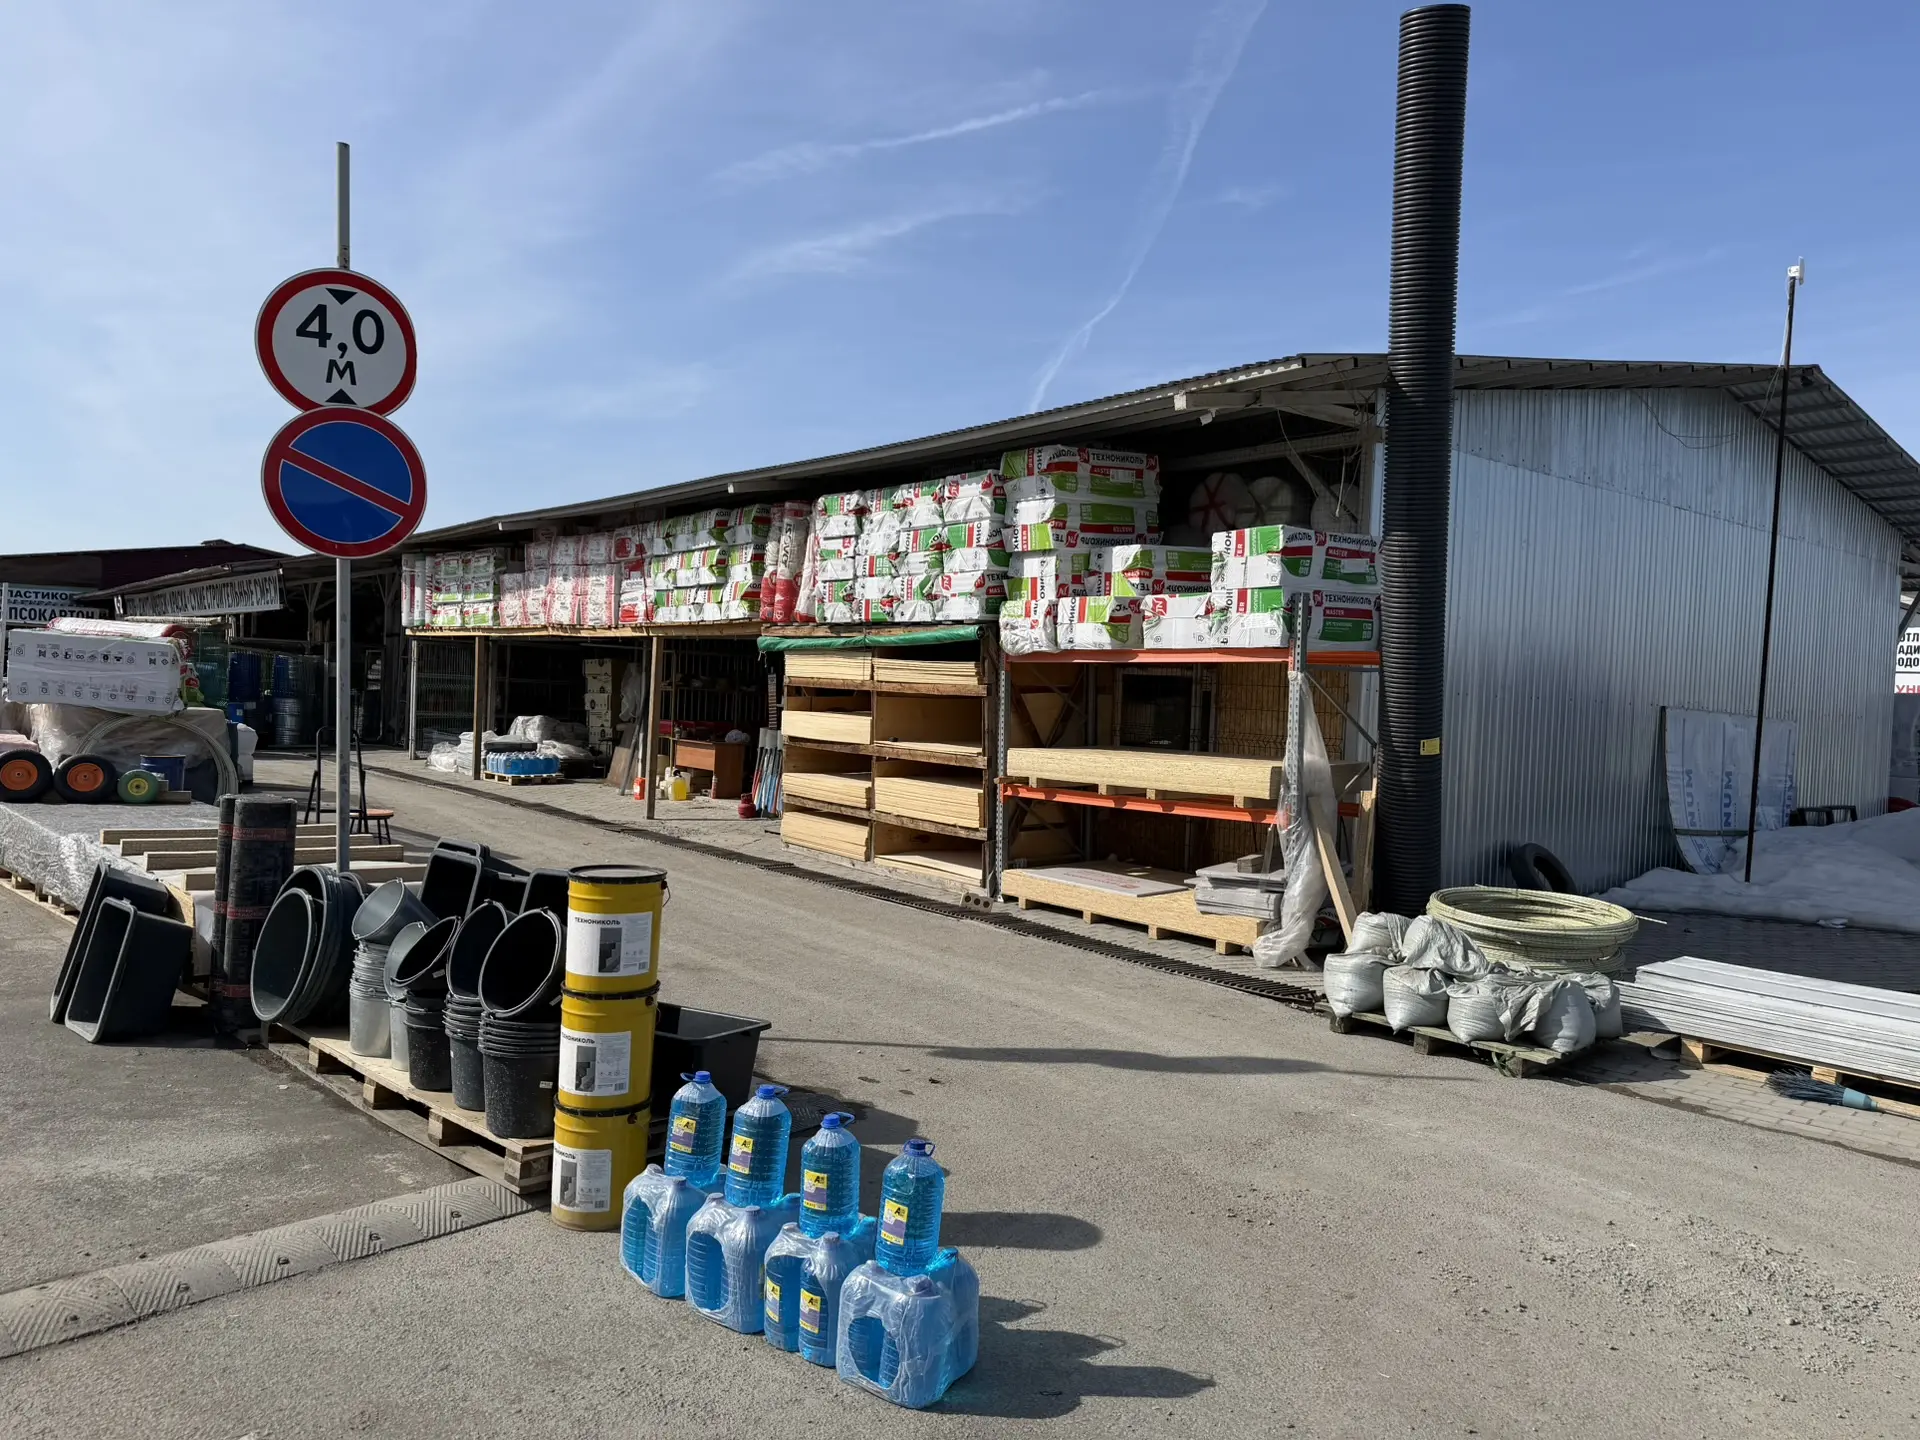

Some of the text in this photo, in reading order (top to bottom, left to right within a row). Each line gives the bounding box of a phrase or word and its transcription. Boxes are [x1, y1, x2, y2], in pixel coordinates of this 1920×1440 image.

[295, 303, 385, 359] 4,0
[1091, 452, 1144, 465] ТЕХНОНИКОЛЬ
[1328, 534, 1377, 547] ТЕХНОНИКОЛЬ
[1325, 594, 1372, 605] ТЕХНОНИКОЛЬ
[574, 916, 621, 926] ТЕХНОНИКОЛЬ
